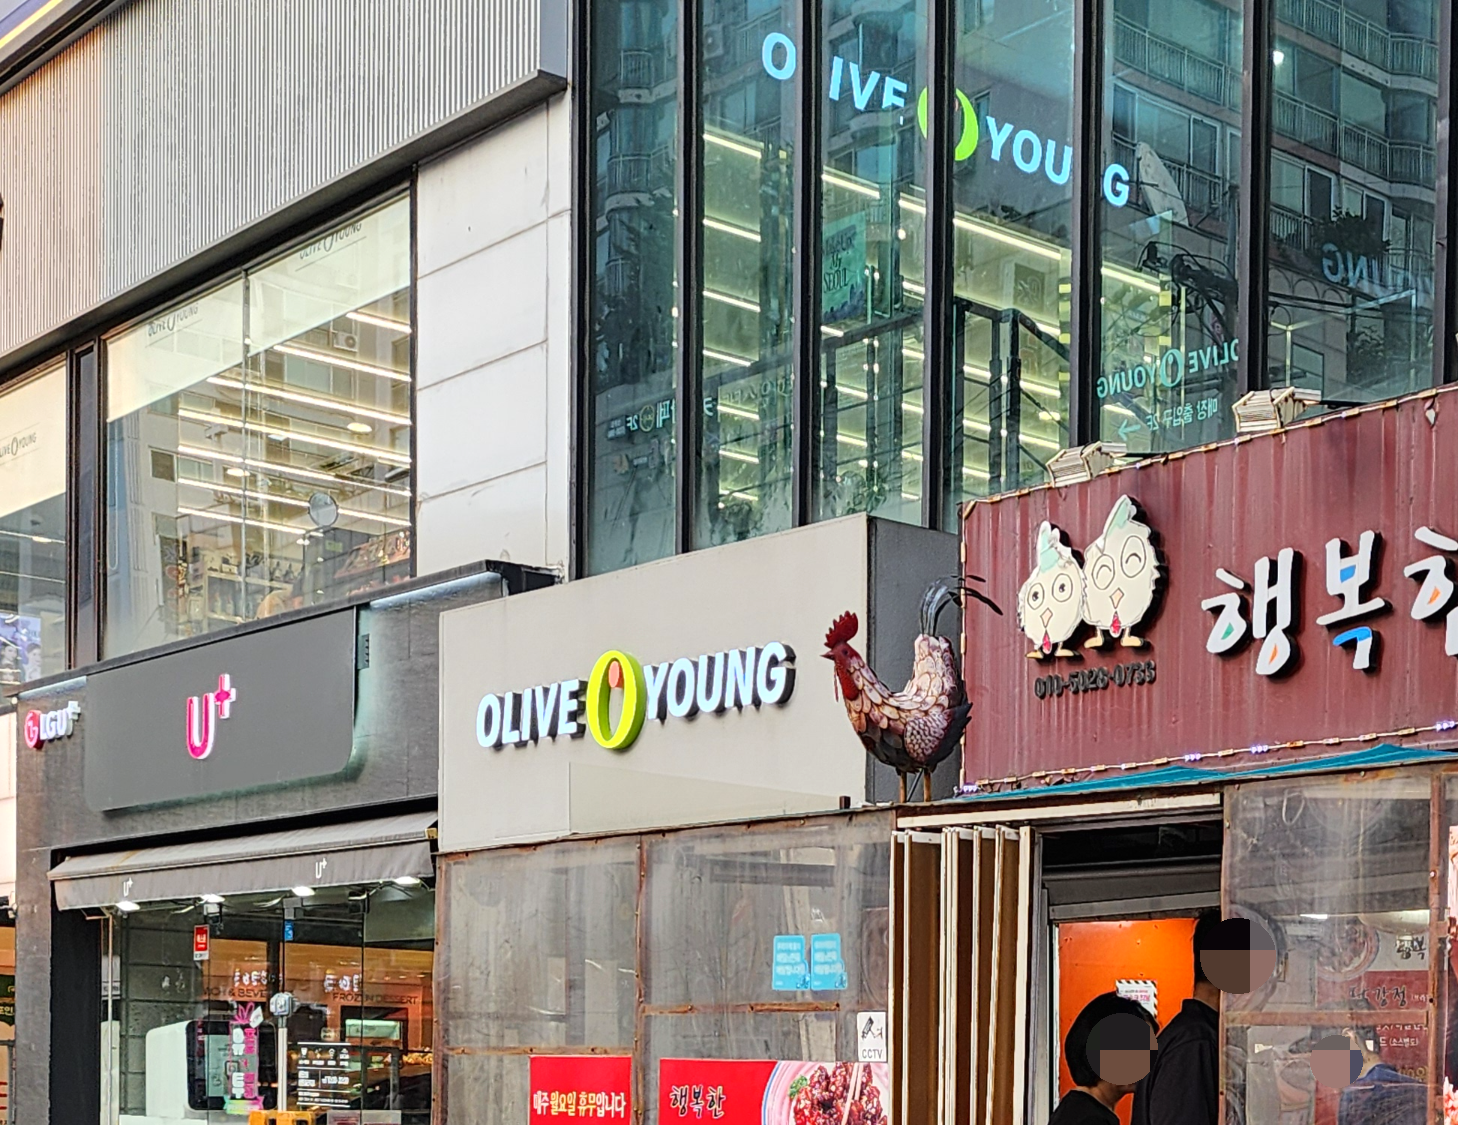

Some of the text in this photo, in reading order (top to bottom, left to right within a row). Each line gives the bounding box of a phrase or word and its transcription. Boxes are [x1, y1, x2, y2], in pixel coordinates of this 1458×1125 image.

[762, 32, 1131, 208] OIVE YOUG
[476, 641, 796, 749] OLIVE YOUNG
[861, 1048, 884, 1060] CCTV
[577, 1091, 627, 1118] 휴무입니다
[670, 1084, 727, 1119] 행복한
